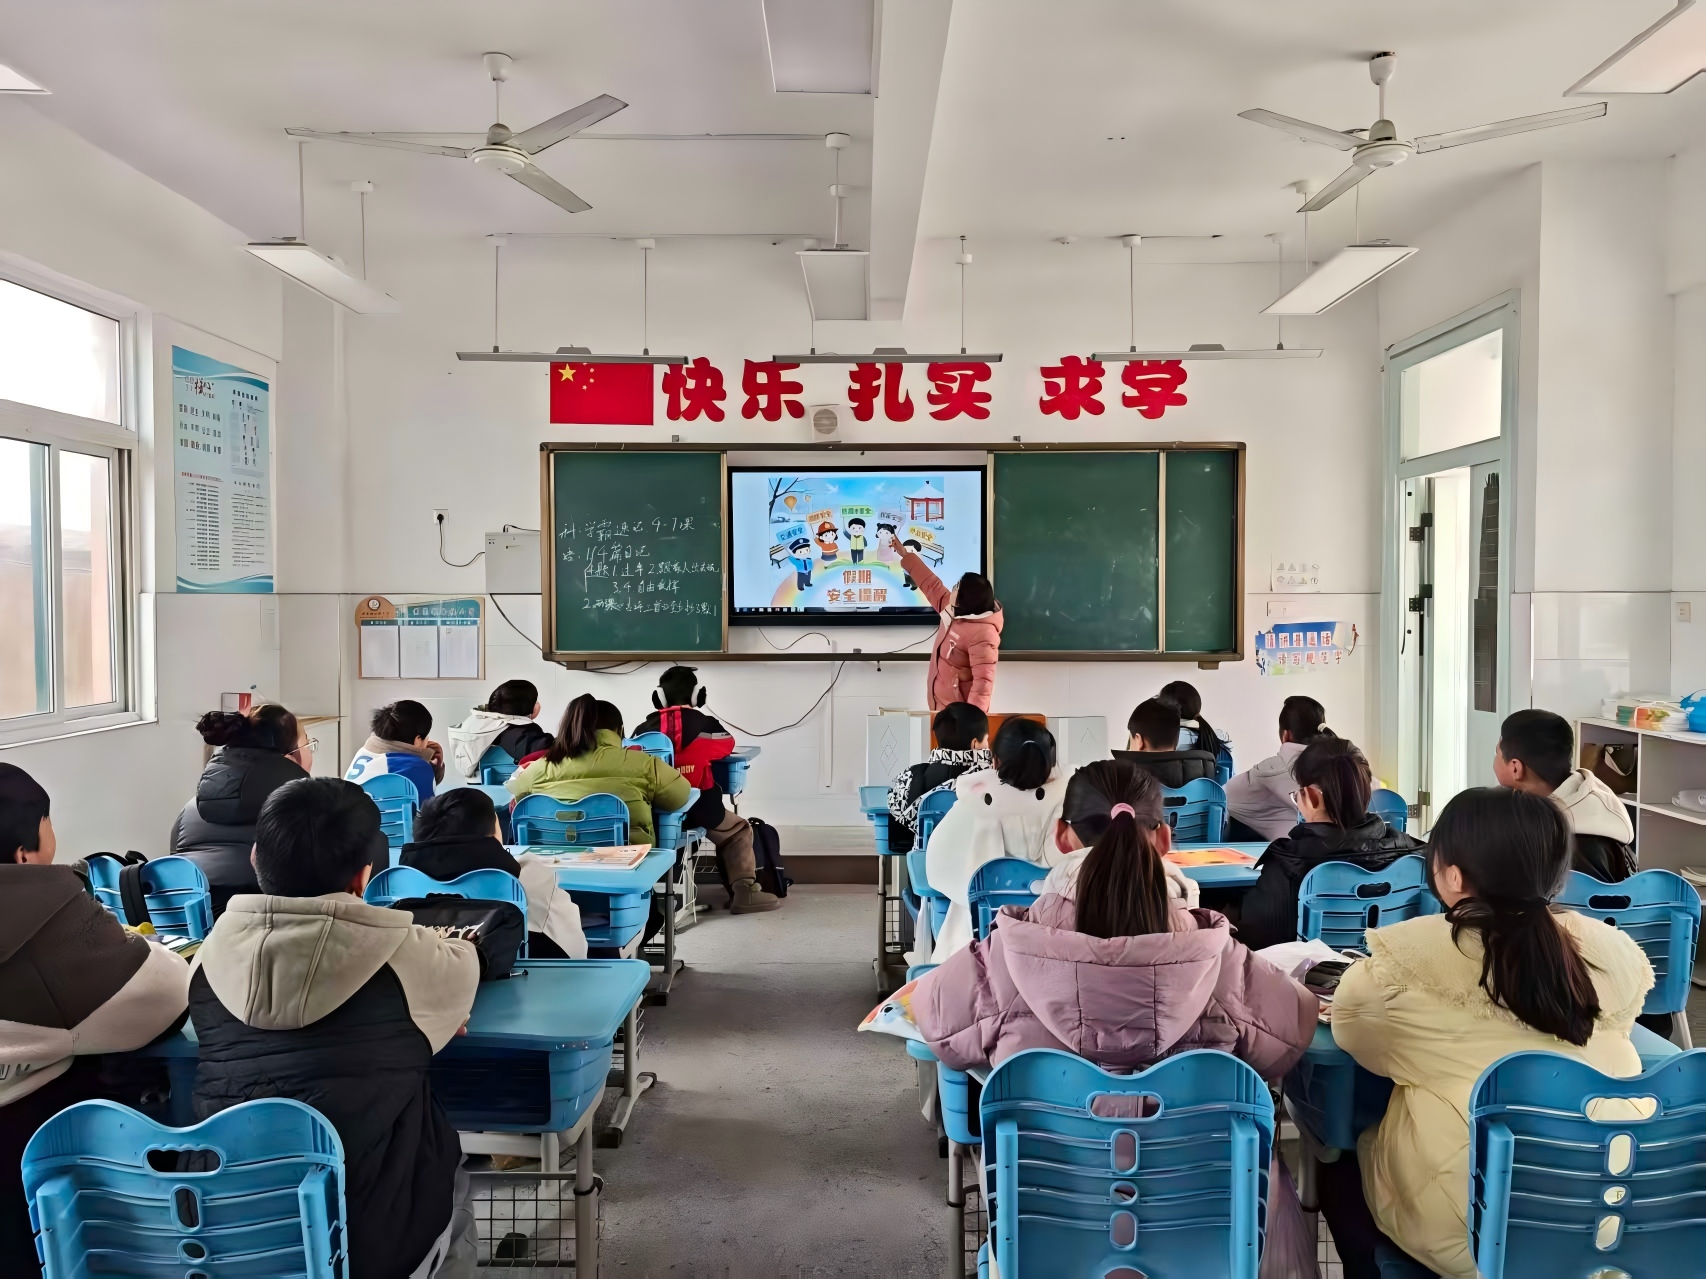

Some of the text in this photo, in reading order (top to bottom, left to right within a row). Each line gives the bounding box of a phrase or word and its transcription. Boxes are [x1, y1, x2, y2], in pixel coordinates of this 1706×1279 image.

[662, 355, 1187, 422] 快乐 扎实 求学
[842, 569, 872, 585] 假期
[827, 588, 888, 604] 安全提醒
